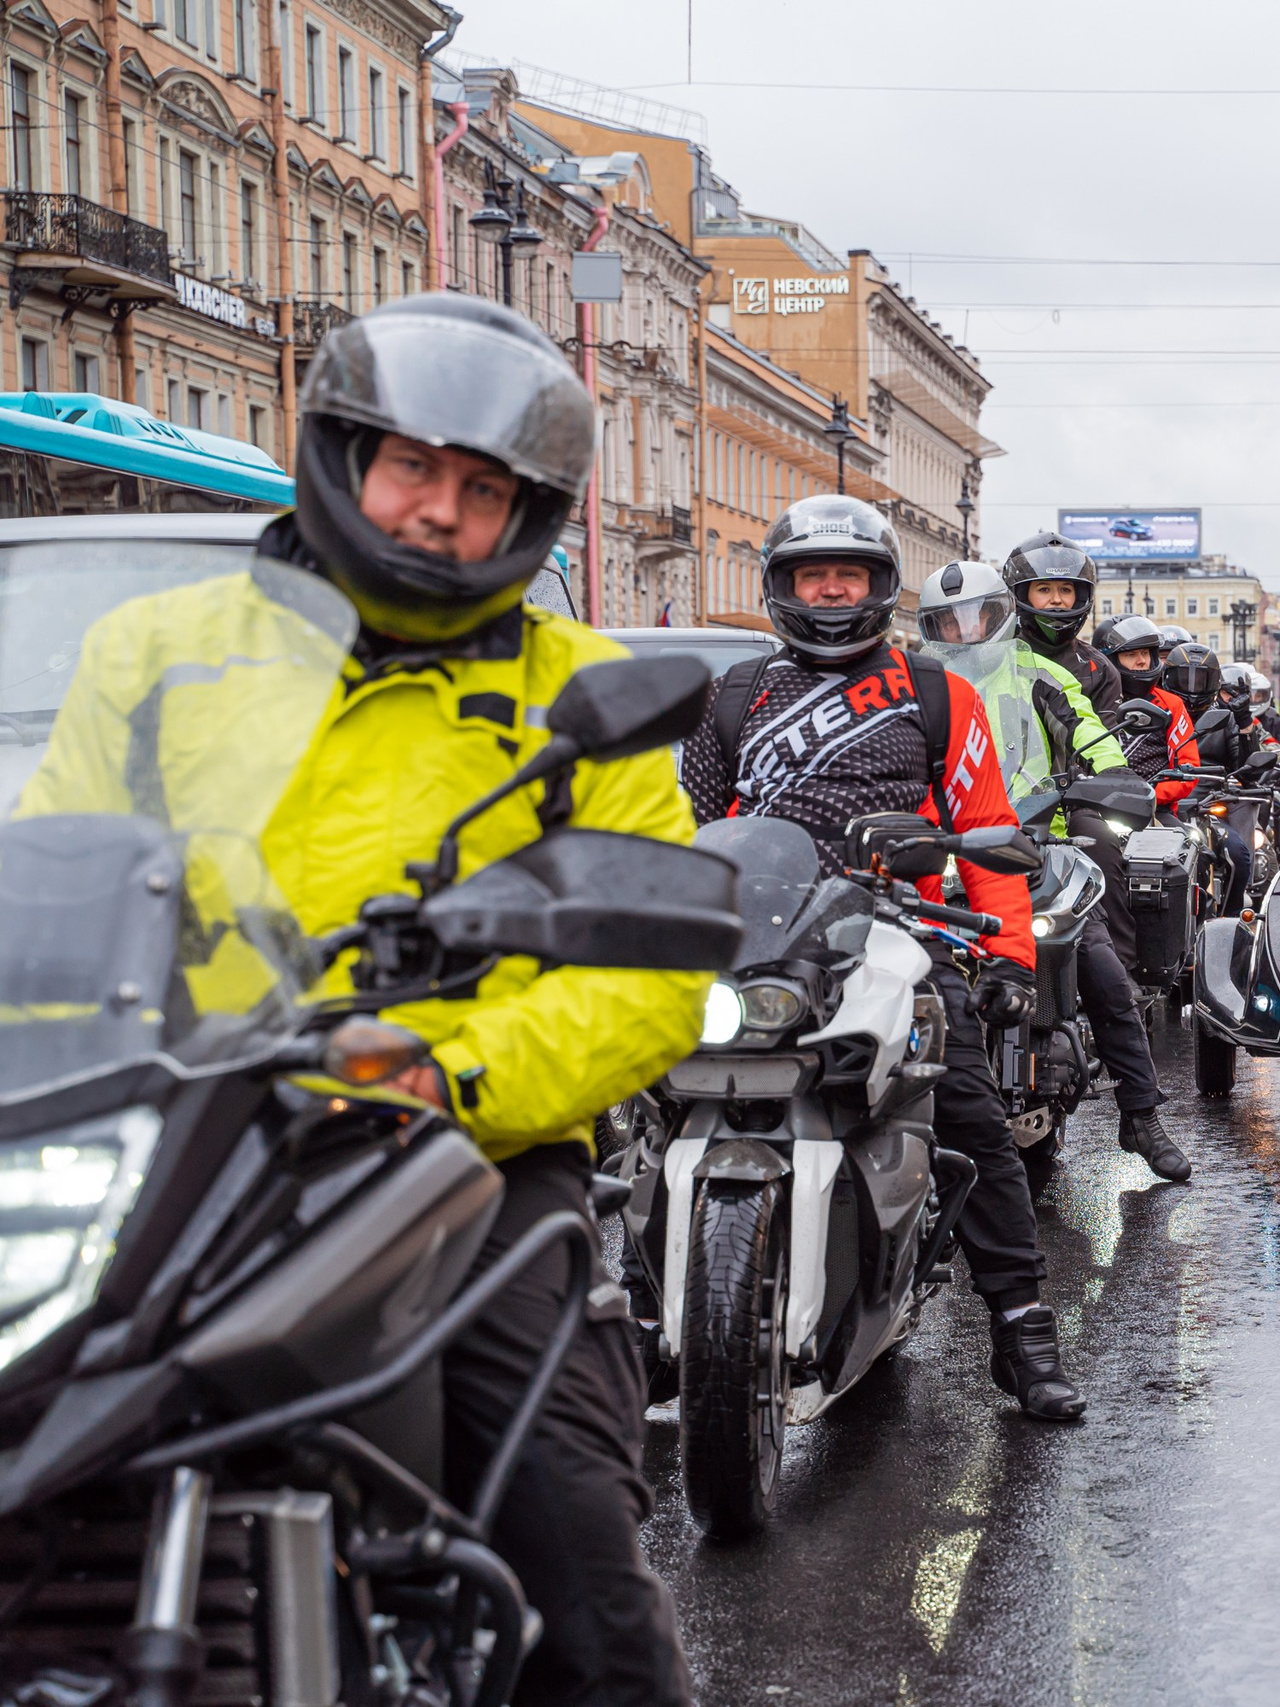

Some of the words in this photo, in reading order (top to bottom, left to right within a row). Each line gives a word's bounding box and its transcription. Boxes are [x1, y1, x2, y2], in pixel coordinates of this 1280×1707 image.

[773, 275, 850, 295] НЕВСКИЙ
[773, 296, 826, 317] ЦЕНТР
[812, 523, 850, 534] SHOEI
